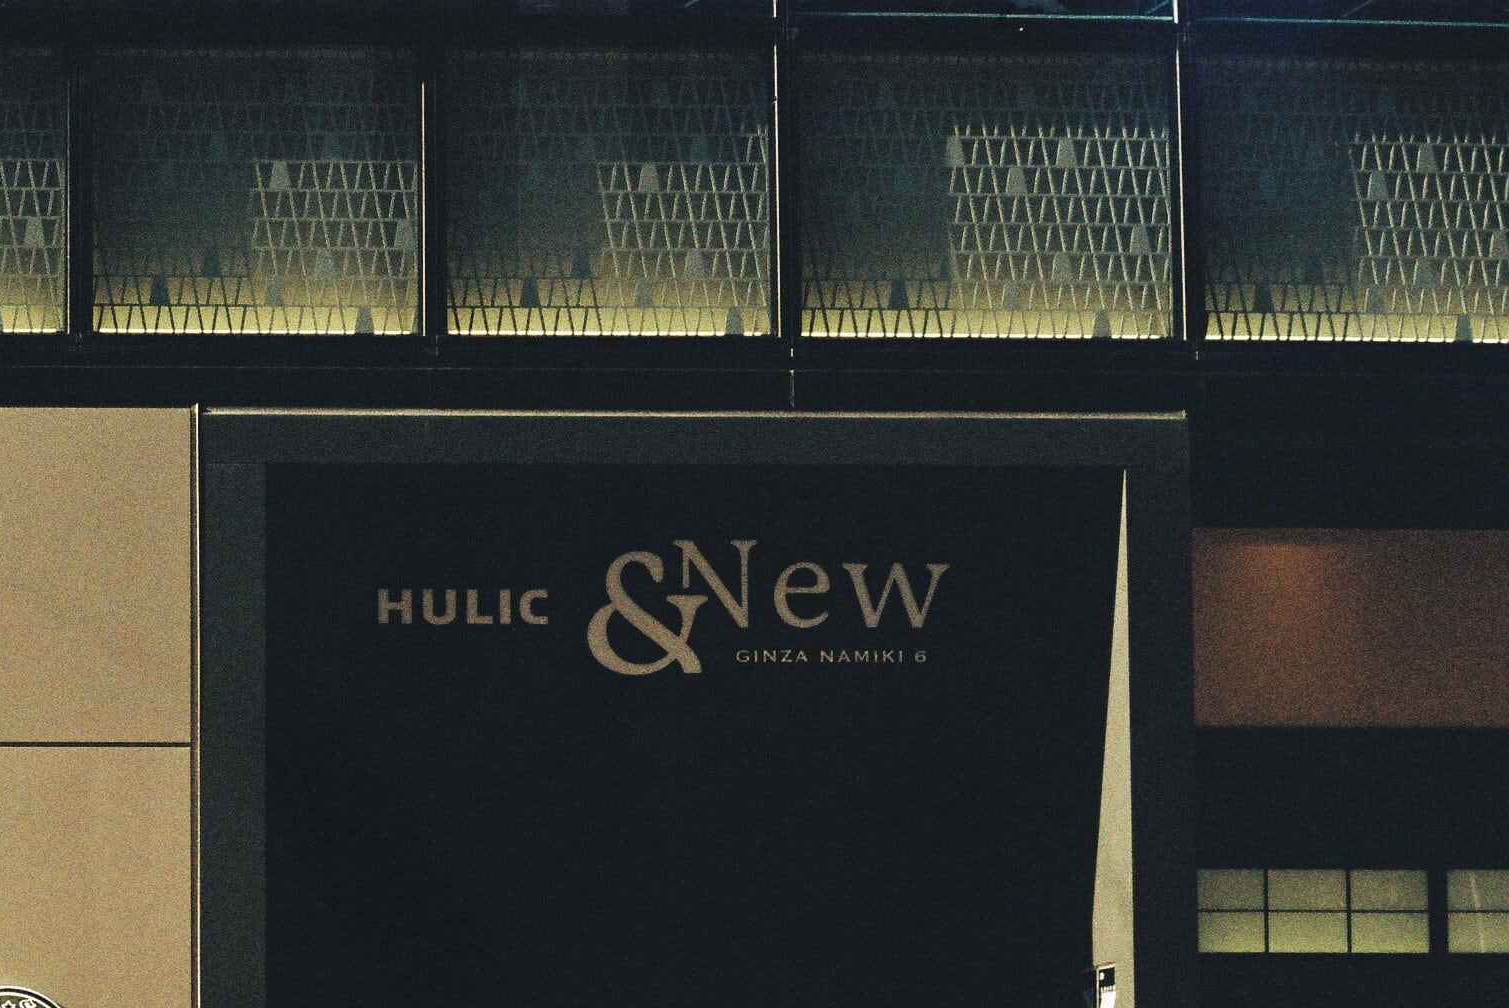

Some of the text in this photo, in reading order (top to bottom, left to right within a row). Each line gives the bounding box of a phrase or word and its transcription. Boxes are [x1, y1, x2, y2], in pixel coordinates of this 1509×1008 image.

[378, 588, 548, 625] HULIC
[736, 650, 927, 664] GINZA NAMIKI 6
